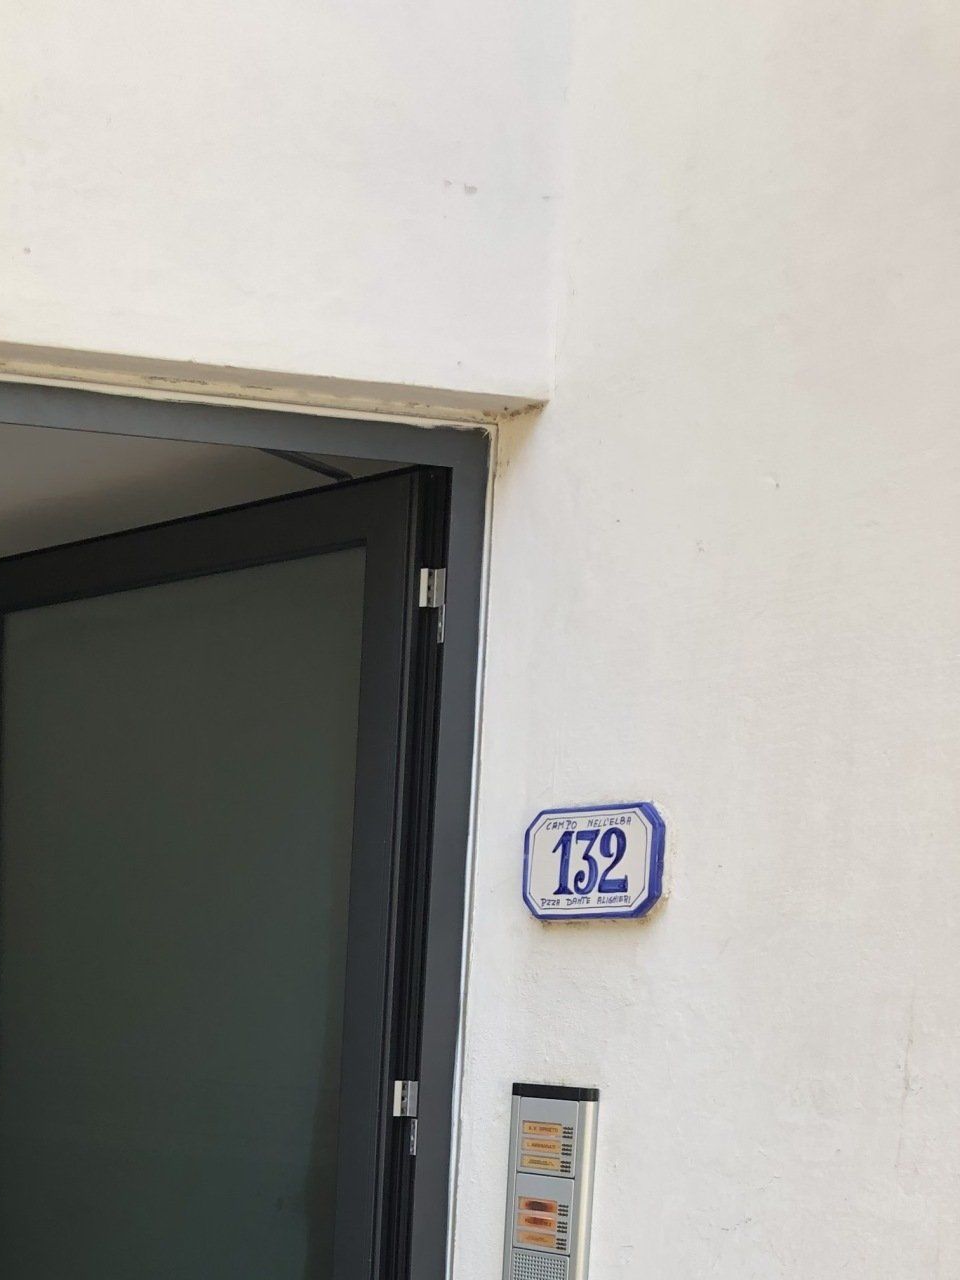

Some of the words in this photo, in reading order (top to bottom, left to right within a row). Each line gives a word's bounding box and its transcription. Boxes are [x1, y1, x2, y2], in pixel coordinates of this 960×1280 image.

[546, 820, 578, 831] CAMPO
[587, 816, 632, 828] NELL'ELBA
[552, 827, 628, 895] 132
[566, 896, 591, 906] DANTE
